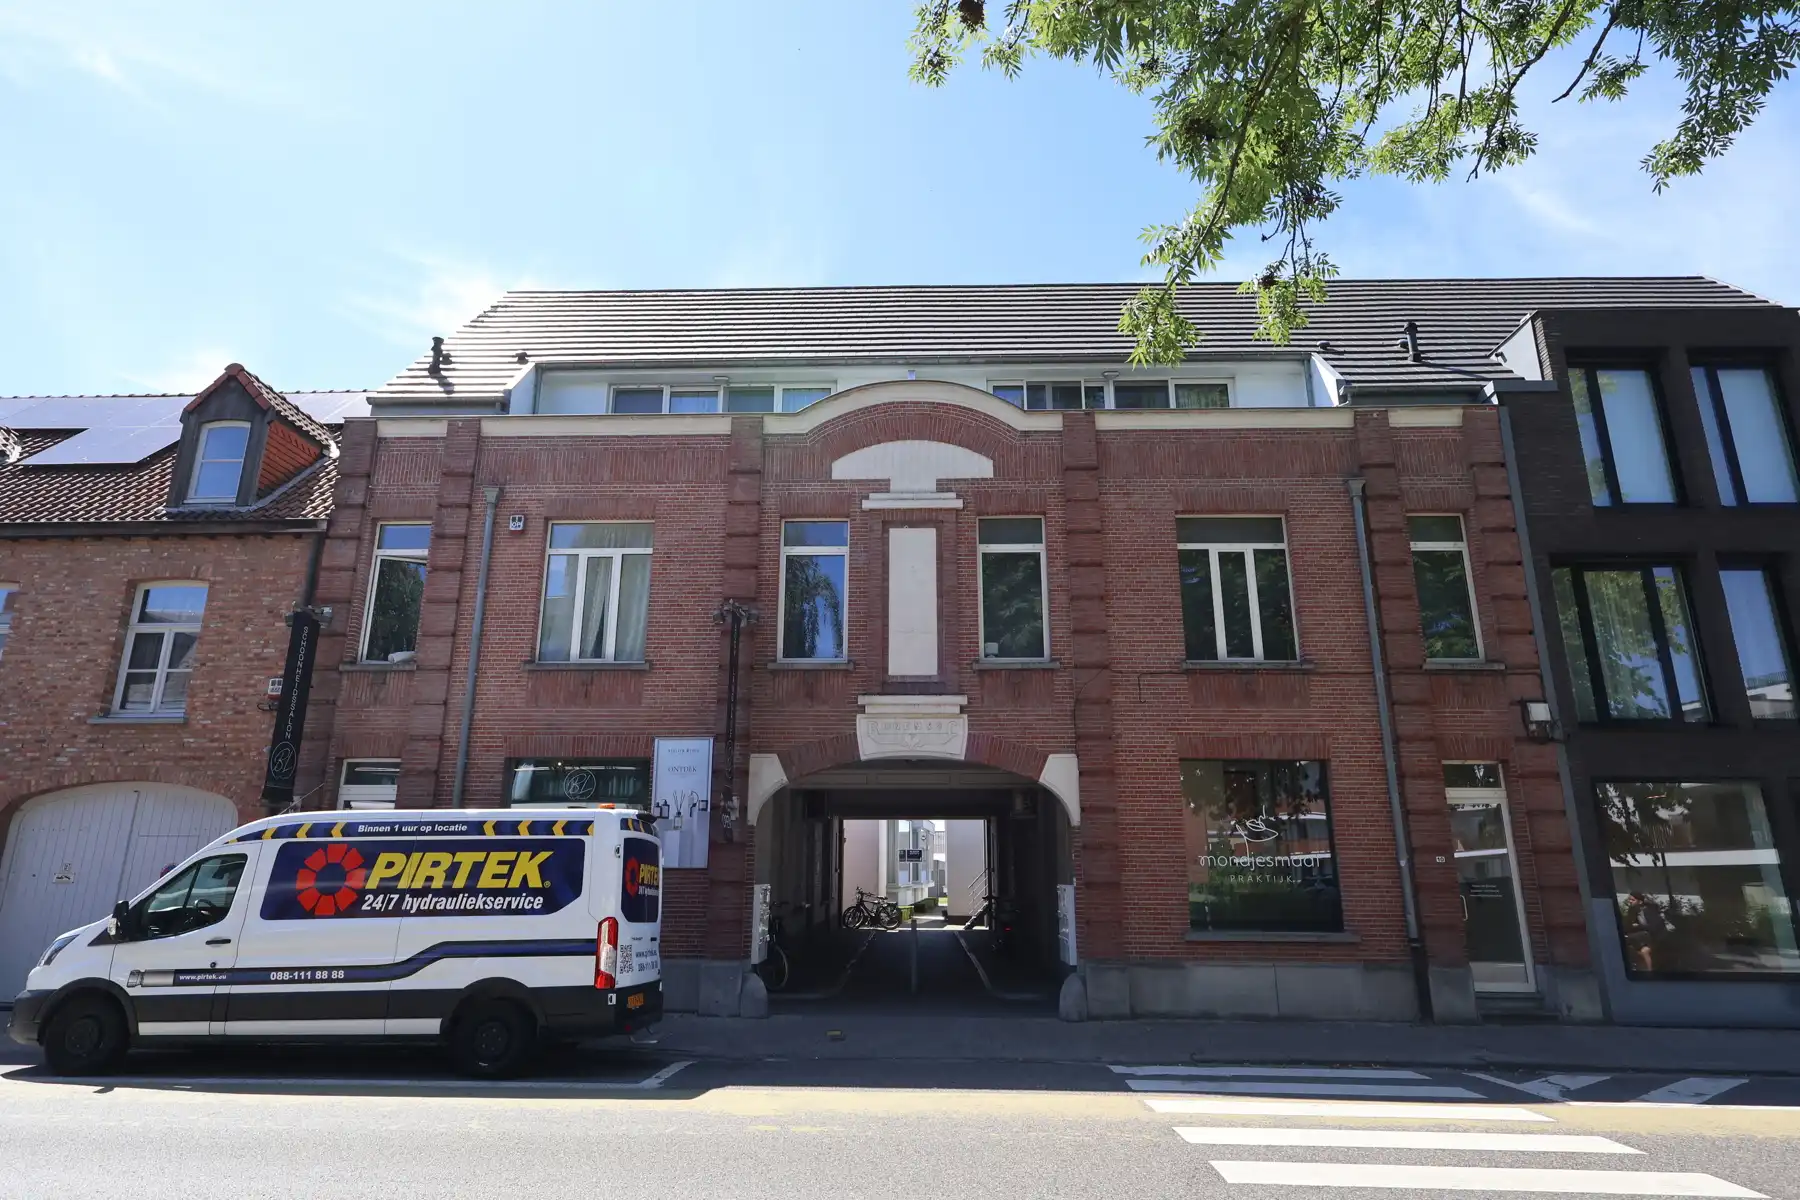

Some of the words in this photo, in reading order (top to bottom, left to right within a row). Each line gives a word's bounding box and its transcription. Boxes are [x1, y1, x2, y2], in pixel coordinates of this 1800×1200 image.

[285, 626, 309, 739] SCHOONHEIDSSALON
[358, 824, 391, 833] Binnen
[393, 824, 400, 832] 1
[420, 825, 432, 833] op
[434, 824, 468, 832] locatie
[365, 851, 554, 890] PIRTEK
[1230, 874, 1292, 883] PRAKTIJK
[361, 893, 400, 912] 24/7
[402, 892, 544, 914] hydrauliekservice
[179, 973, 227, 981] www.pirtek.eu
[270, 971, 312, 980] 088-111
[315, 970, 328, 979] 88
[331, 970, 345, 979] 88
